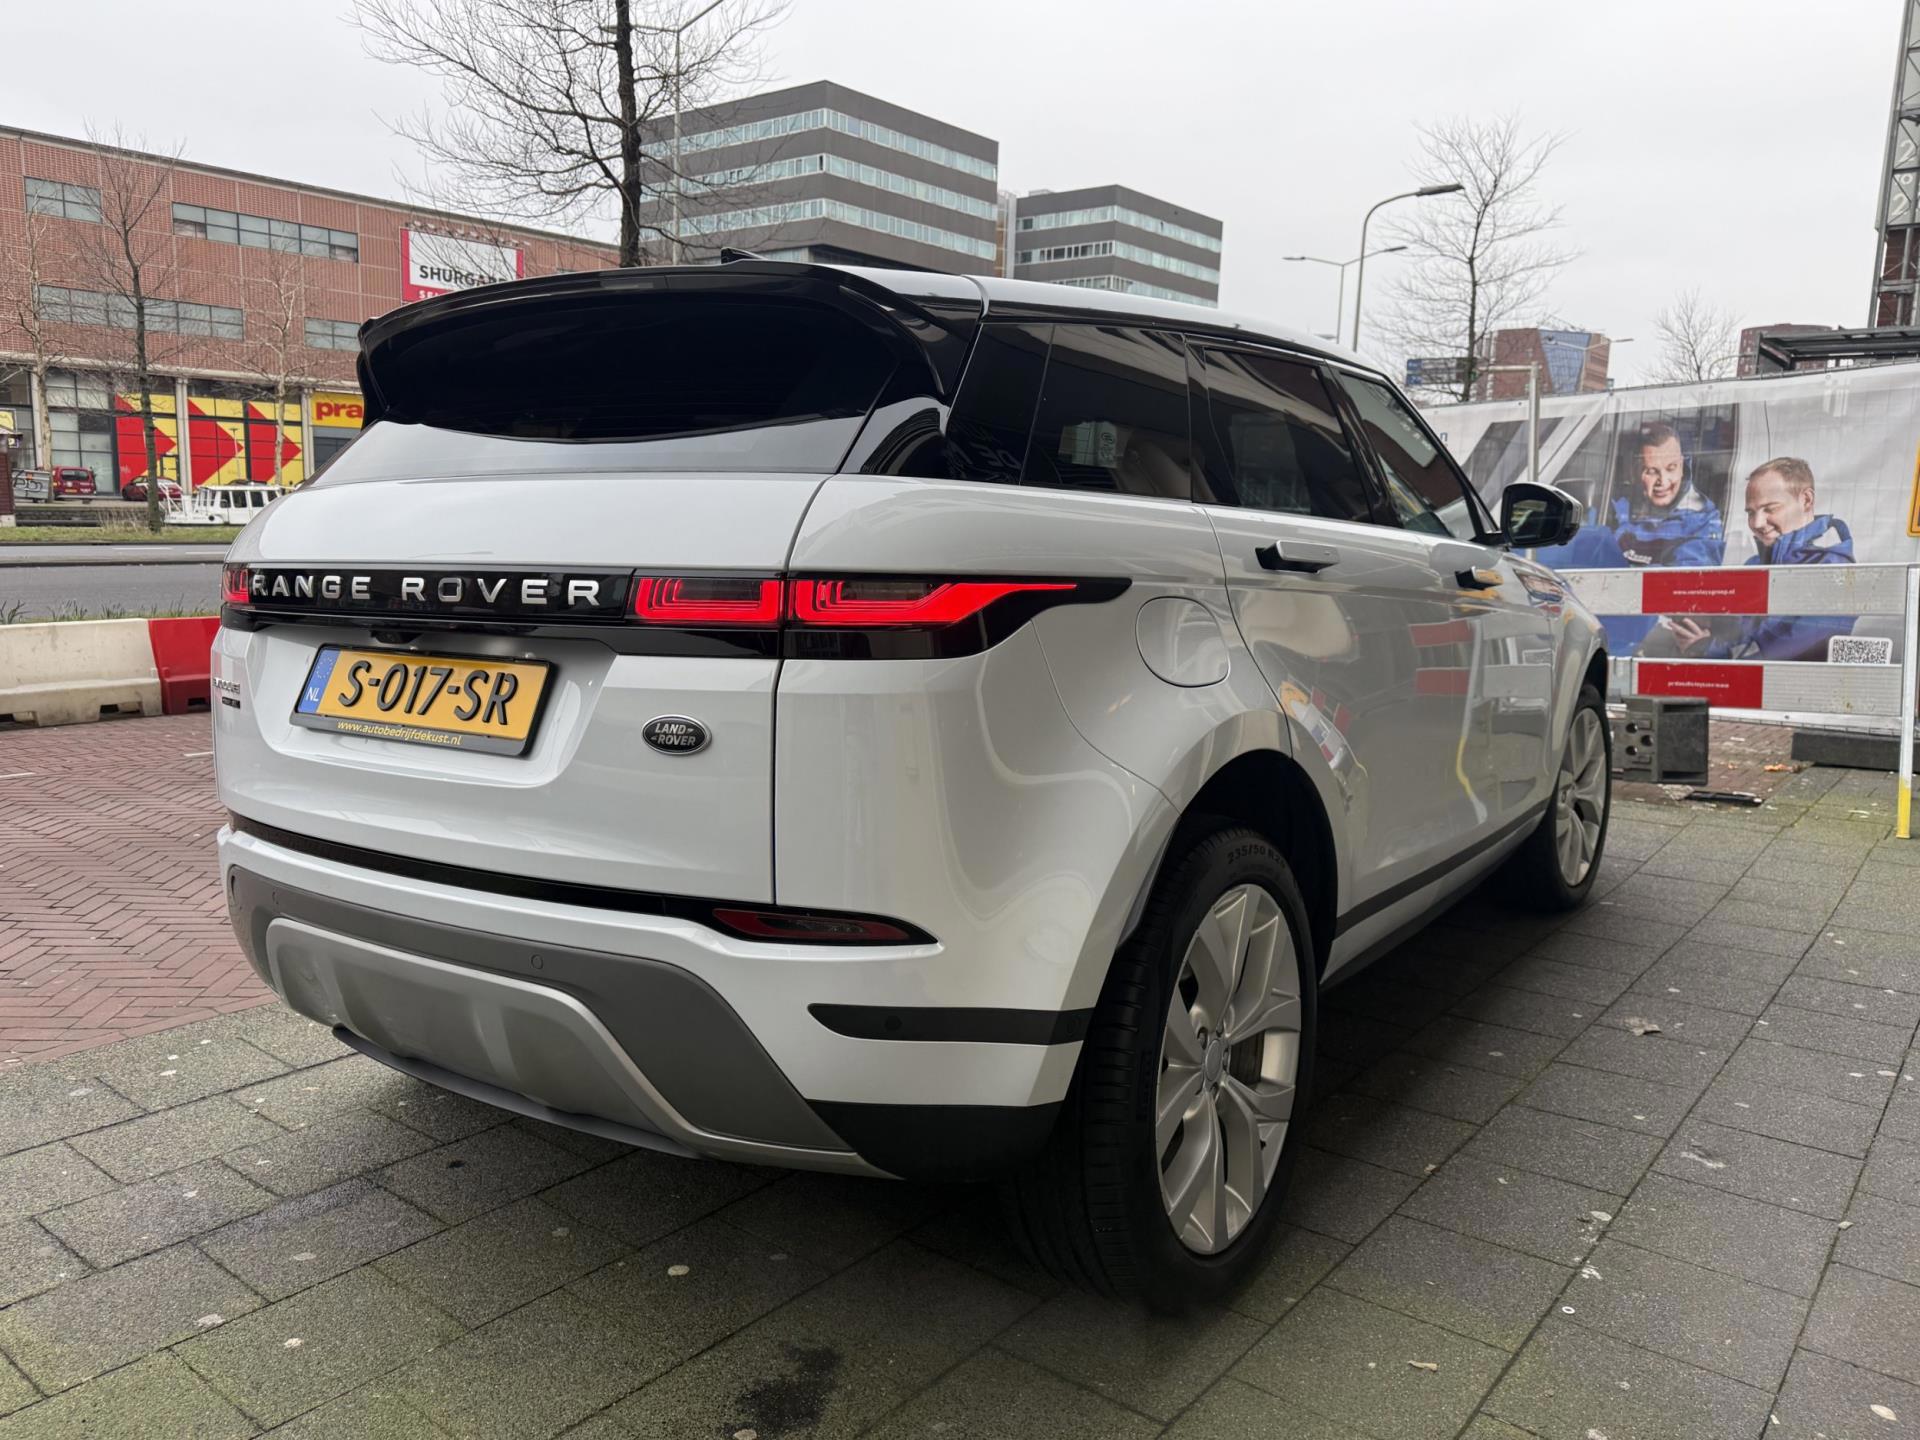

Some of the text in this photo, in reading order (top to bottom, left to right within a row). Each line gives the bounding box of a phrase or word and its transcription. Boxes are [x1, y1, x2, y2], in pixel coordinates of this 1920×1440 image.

[420, 265, 507, 287] SHURGAR
[251, 574, 600, 606] RANGE ROVER
[306, 660, 519, 725] NL S-017-SR
[337, 720, 462, 746] www.autobedrijfdekust.nl
[655, 723, 687, 735] LAND
[657, 734, 696, 746] ROVER
[1227, 843, 1266, 865] 235/50
